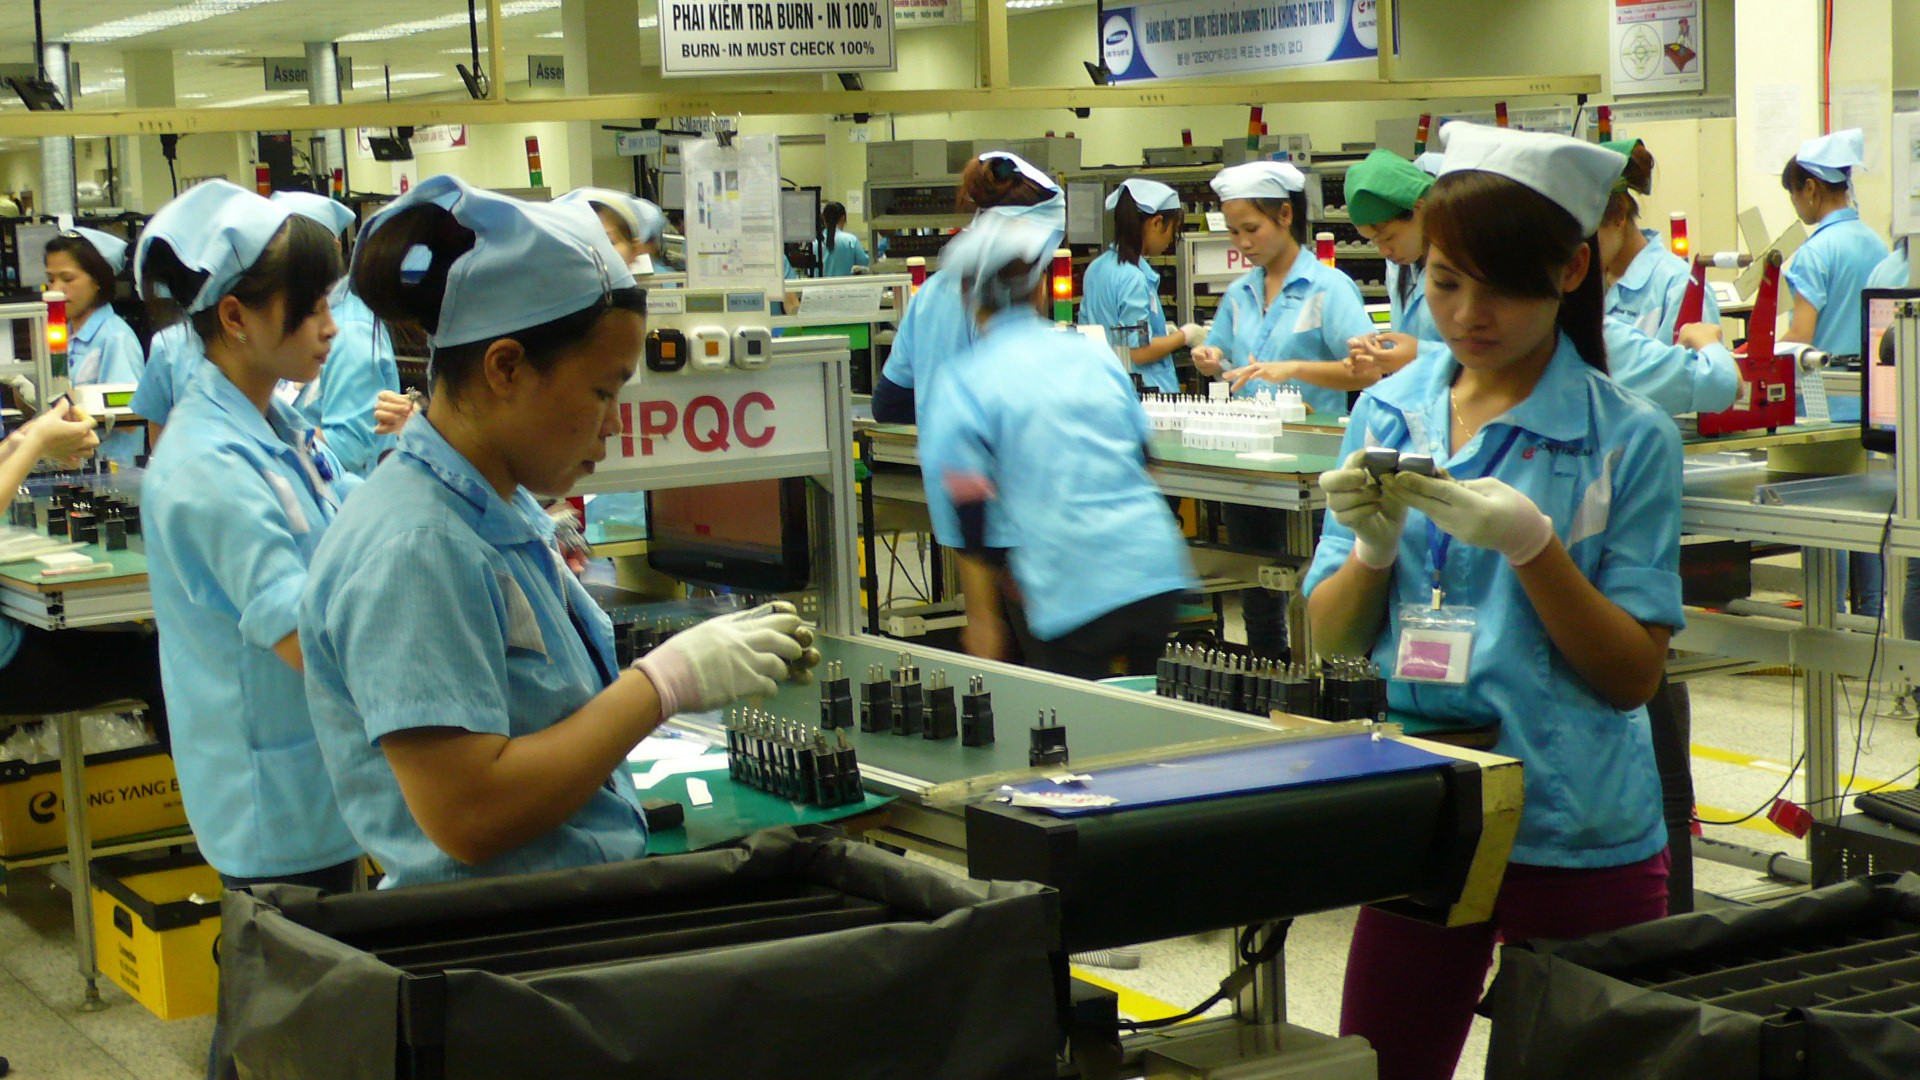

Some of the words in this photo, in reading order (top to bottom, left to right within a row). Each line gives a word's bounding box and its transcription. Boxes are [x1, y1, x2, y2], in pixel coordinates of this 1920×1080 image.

[747, 3, 774, 31] TRA
[778, 3, 814, 30] BURN
[827, 3, 841, 29] IN
[845, 3, 882, 29] 100%
[747, 42, 786, 57] MUST
[790, 42, 836, 56] CHECK
[840, 41, 875, 55] 100%
[620, 391, 776, 457] IPQC
[119, 782, 166, 801] YANG
